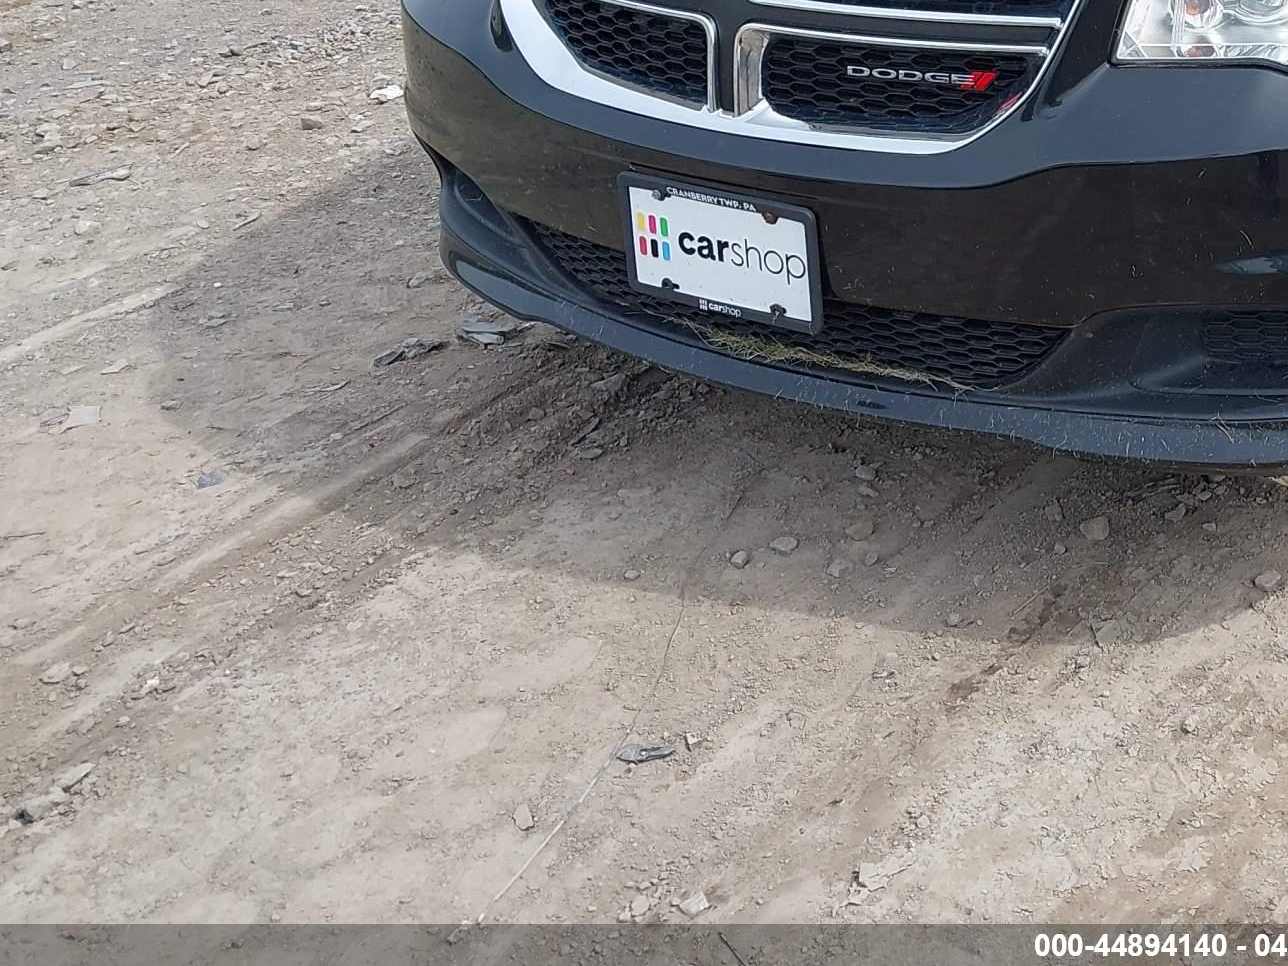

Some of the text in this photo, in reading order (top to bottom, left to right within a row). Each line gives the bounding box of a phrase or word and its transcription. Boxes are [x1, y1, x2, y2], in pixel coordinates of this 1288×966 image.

[846, 65, 976, 85] DODGE
[666, 186, 718, 205] CRANBERRY
[742, 201, 757, 212] PA
[678, 231, 806, 286] carshop
[708, 302, 742, 319] carshop
